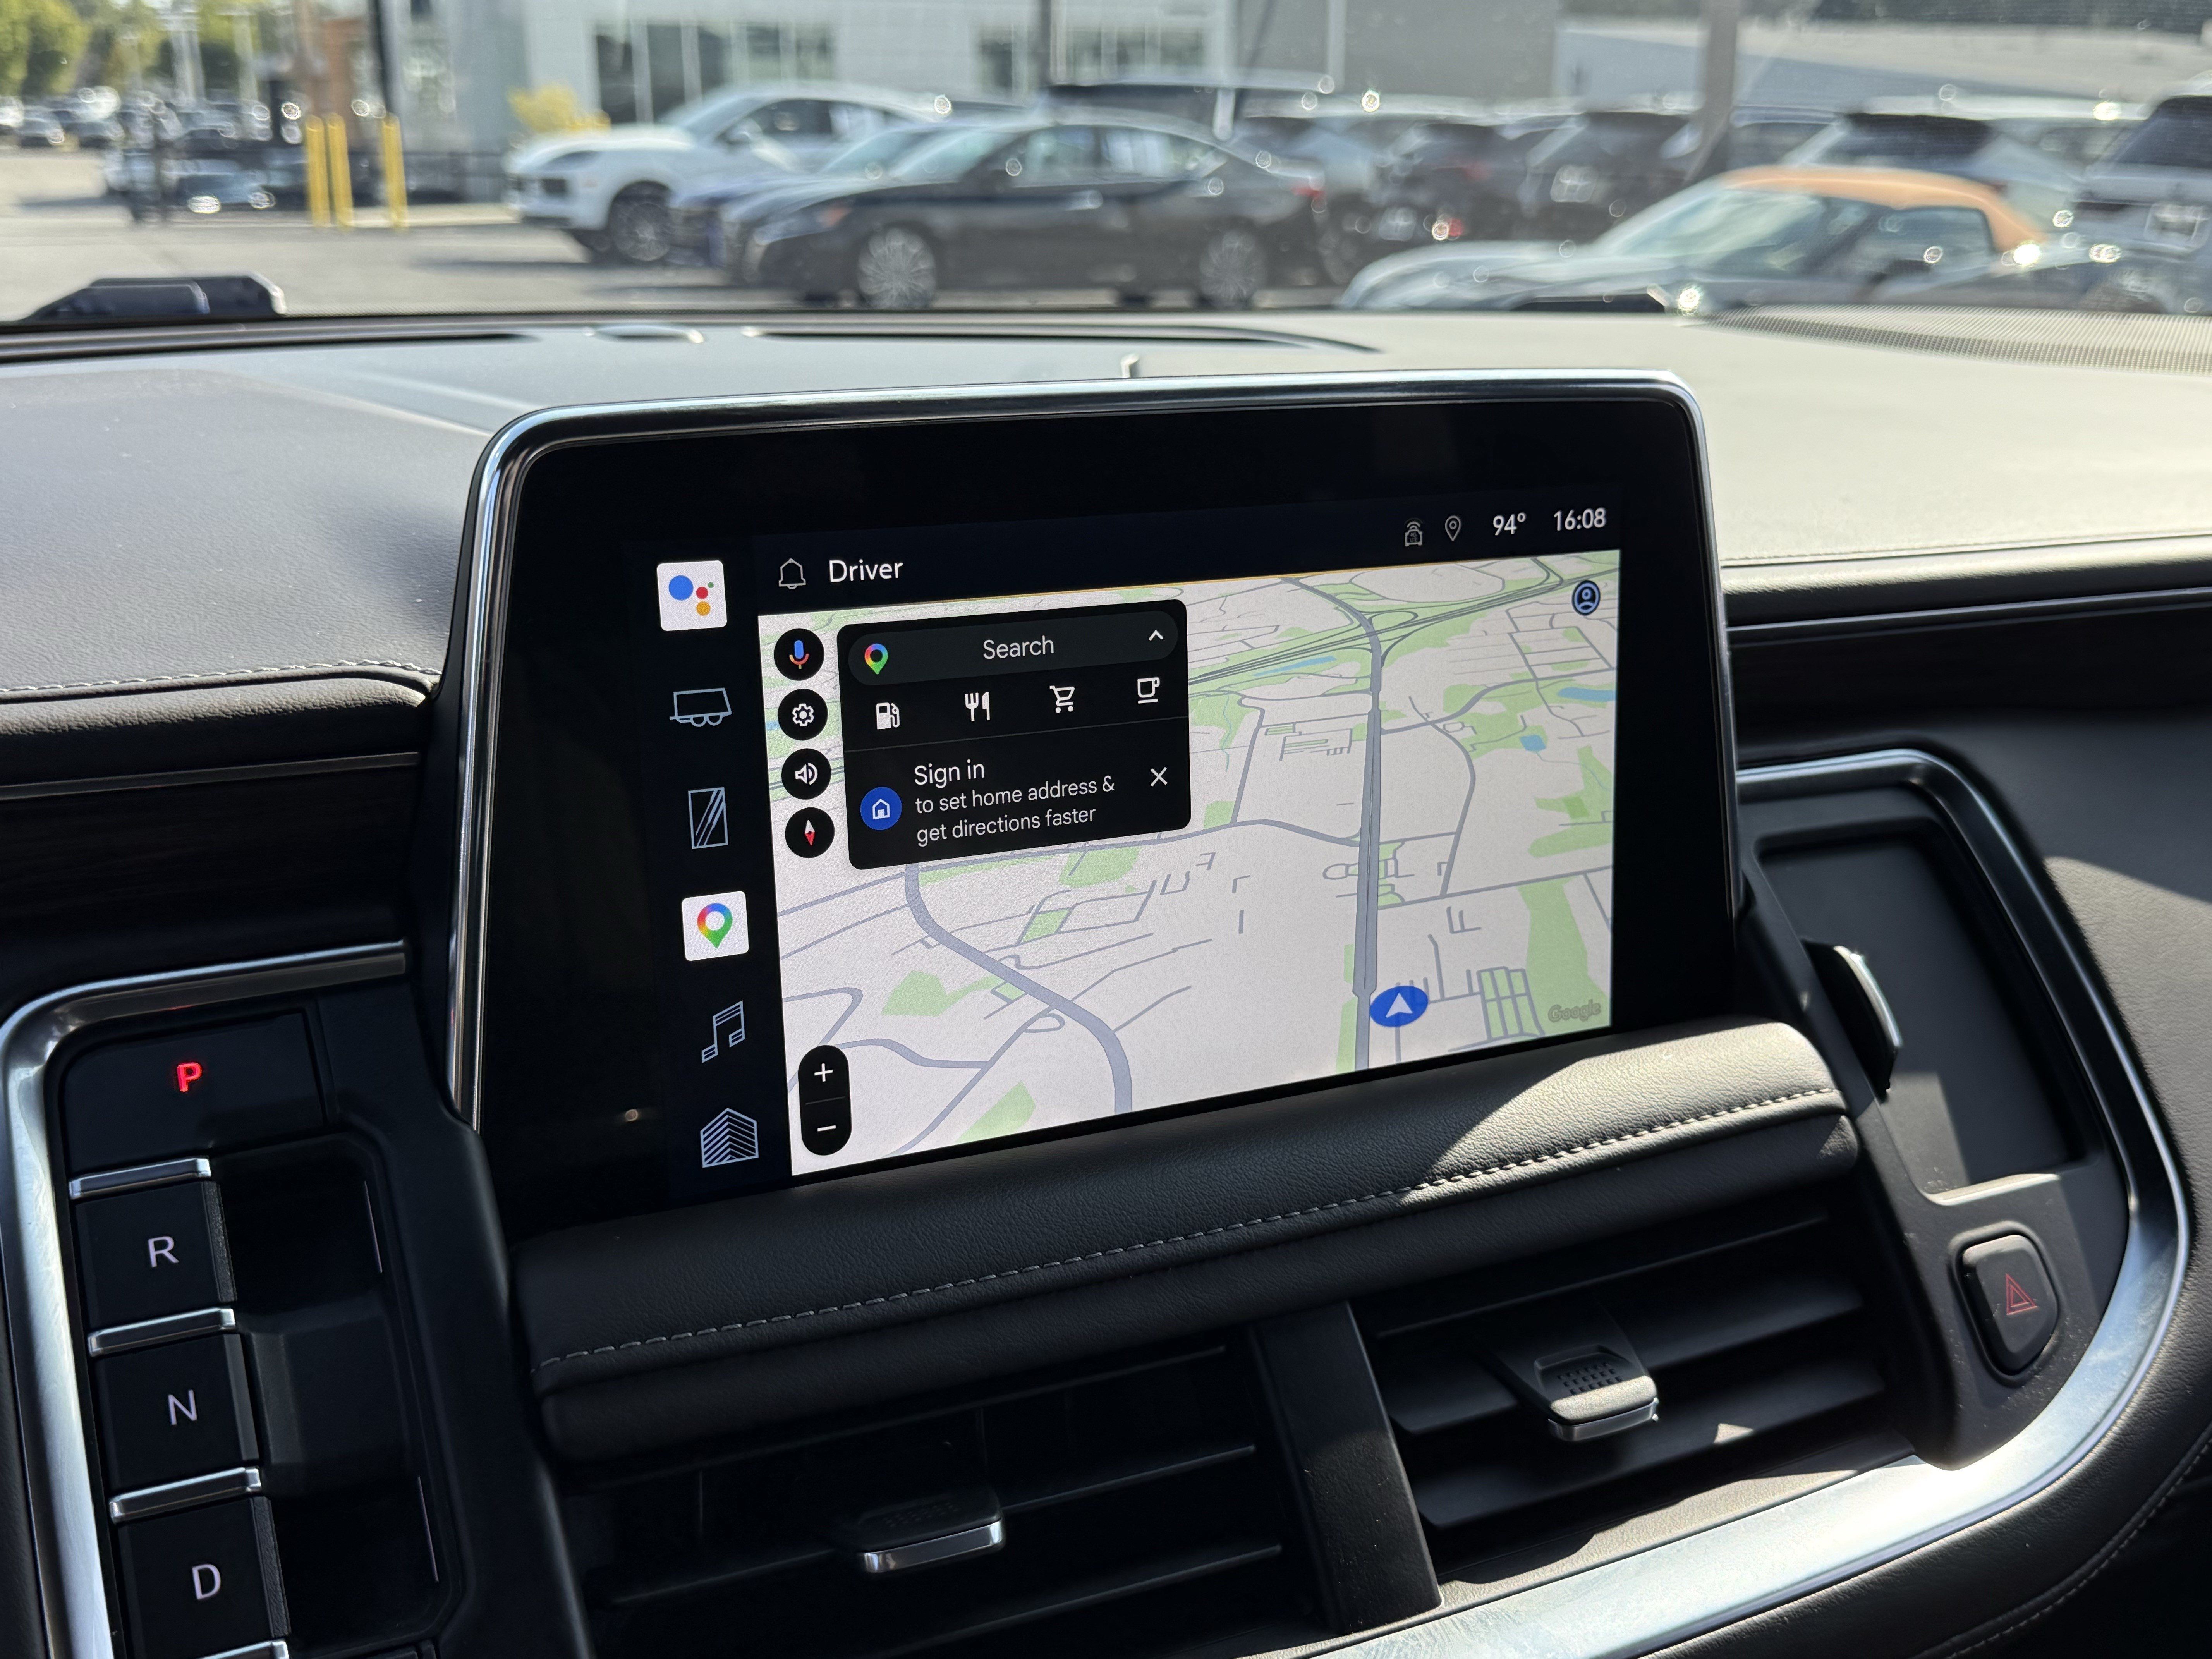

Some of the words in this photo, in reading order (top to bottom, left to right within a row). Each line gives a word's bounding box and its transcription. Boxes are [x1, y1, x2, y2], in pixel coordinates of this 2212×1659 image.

[1493, 512, 1526, 536] 94°
[1554, 507, 1606, 531] 16:08
[829, 559, 903, 582] Driver
[983, 635, 1054, 659] Search
[914, 763, 960, 788] Sign
[967, 759, 985, 780] in
[915, 798, 934, 813] to
[939, 793, 967, 811] set
[972, 789, 1022, 807] home
[1028, 780, 1097, 801] address
[1102, 775, 1115, 792] &
[917, 824, 947, 847] get
[952, 814, 1041, 838] directions
[1045, 809, 1096, 826] faster
[1548, 999, 1601, 1022] Google
[177, 1062, 202, 1092] P
[148, 1236, 179, 1267] R
[168, 1390, 197, 1425] N
[192, 1564, 221, 1600] D
